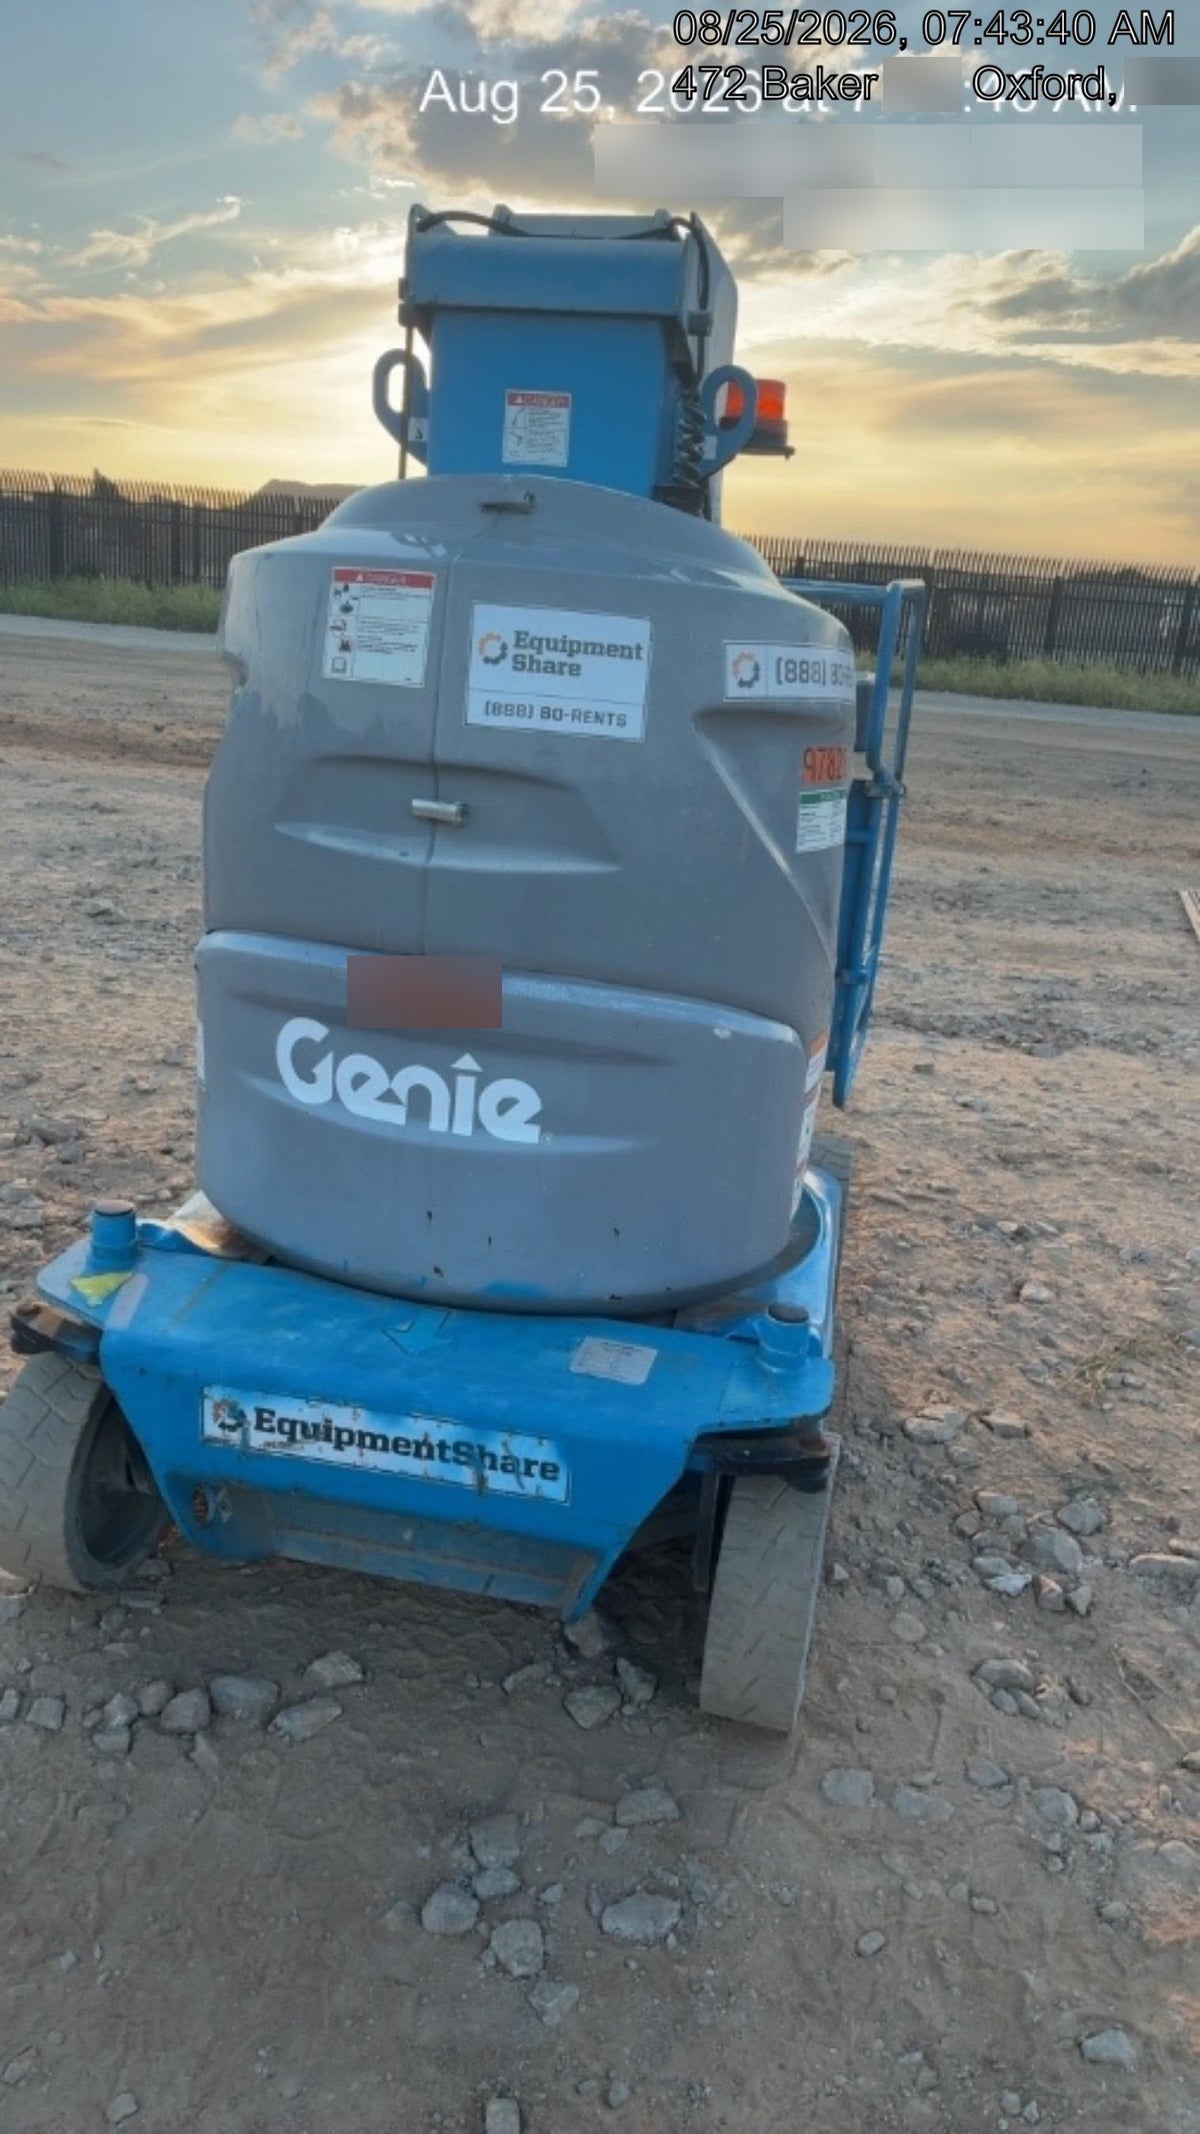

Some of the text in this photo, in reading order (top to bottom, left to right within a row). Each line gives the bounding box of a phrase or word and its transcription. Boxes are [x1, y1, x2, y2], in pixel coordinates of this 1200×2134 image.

[513, 630, 644, 661] Equipment
[511, 654, 582, 677] Share
[484, 699, 627, 728] (888) 80-RENTS
[276, 1016, 542, 1144] Genie
[254, 1406, 561, 1482] EquipmentShare
